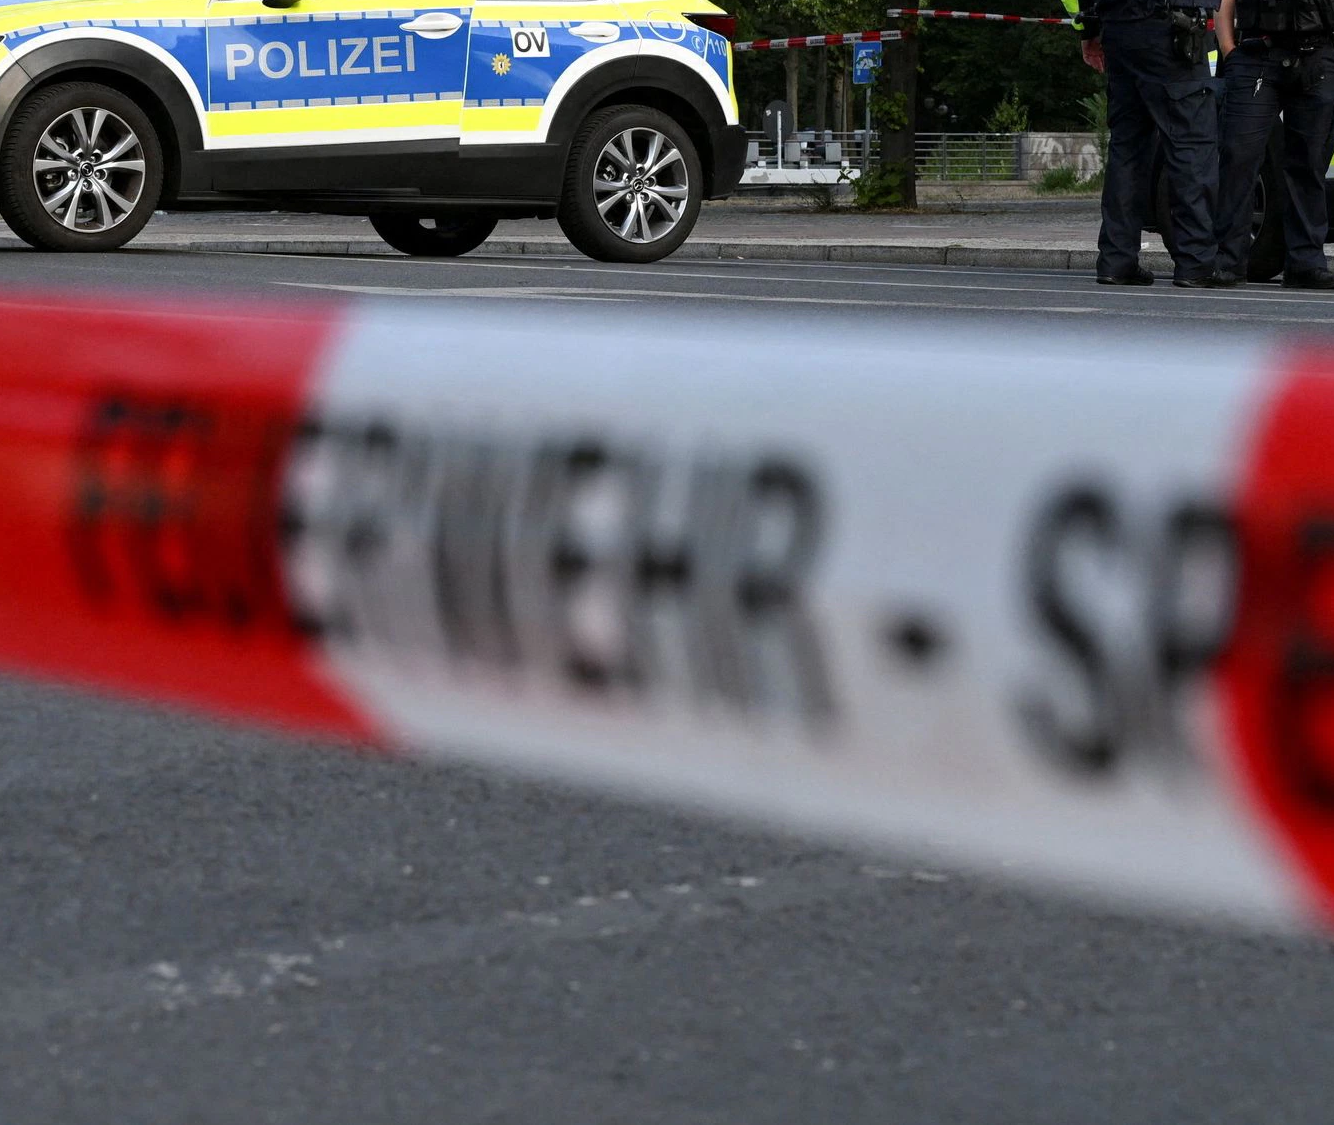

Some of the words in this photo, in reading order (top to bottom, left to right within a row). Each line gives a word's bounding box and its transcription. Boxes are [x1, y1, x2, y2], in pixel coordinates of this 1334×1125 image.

[225, 34, 416, 81] POLIZEI
[514, 30, 546, 53] OV
[708, 38, 727, 57] 110
[72, 387, 845, 751] FEUERWEHR
